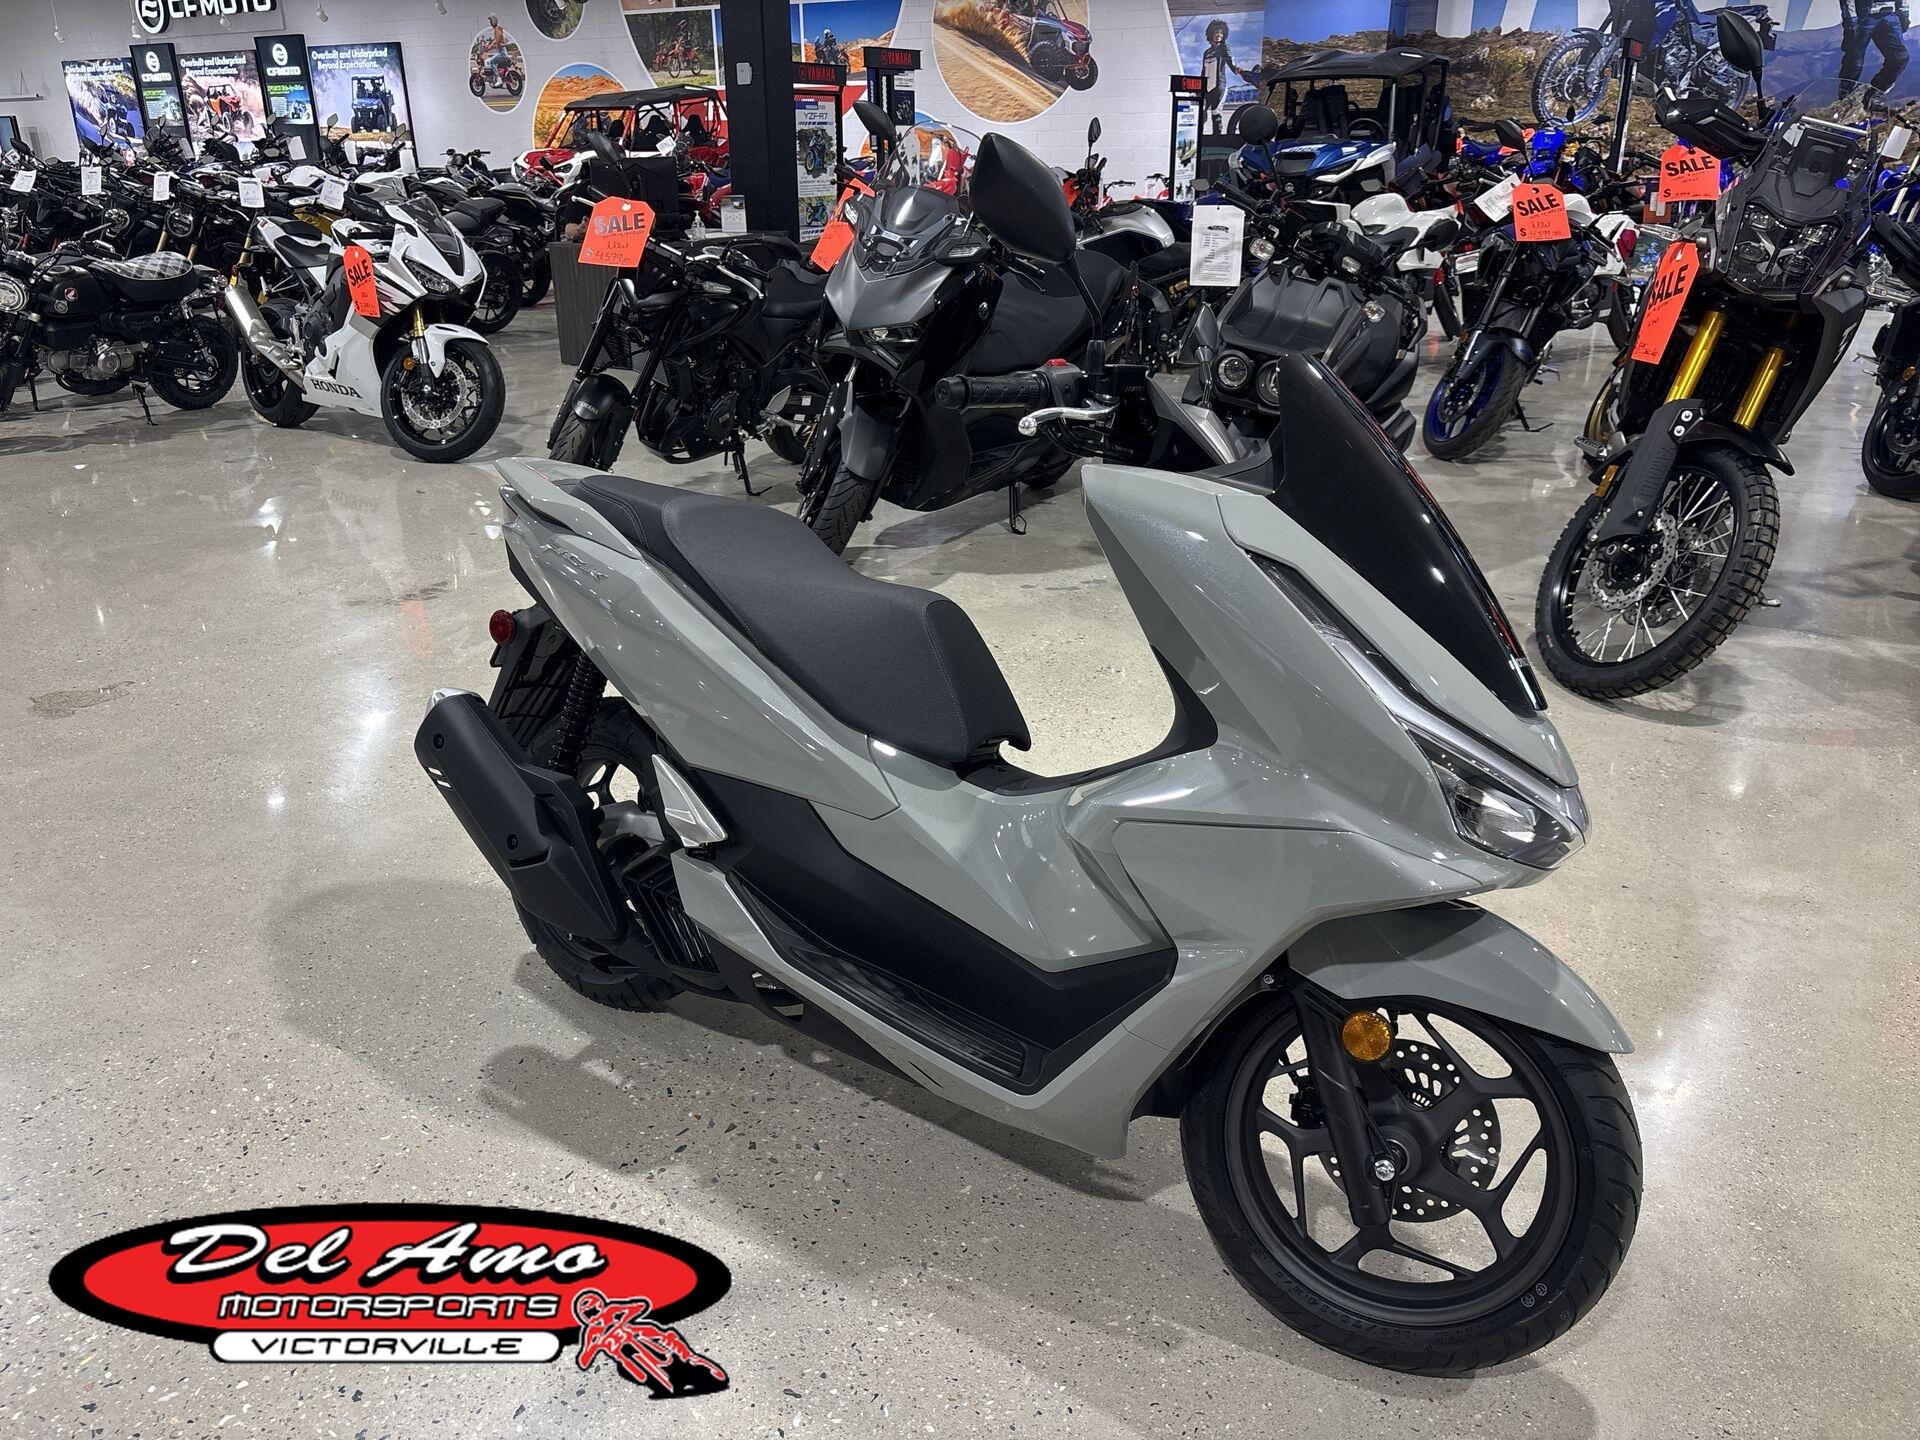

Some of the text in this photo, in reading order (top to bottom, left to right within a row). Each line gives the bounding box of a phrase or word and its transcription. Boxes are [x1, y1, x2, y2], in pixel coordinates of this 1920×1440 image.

[311, 47, 388, 60] Overbuilt and Underpriced
[887, 51, 912, 65] YAMAHA
[317, 60, 339, 71] Beyond
[807, 67, 836, 81] YAMAHA
[1665, 155, 1716, 177] SALE
[1663, 189, 1672, 198] $
[1516, 193, 1560, 217] SALE
[594, 212, 646, 235] SALE
[1520, 228, 1527, 237] $
[347, 258, 371, 287] SALE
[1648, 263, 1689, 310] SALE
[310, 378, 364, 399] HONDA
